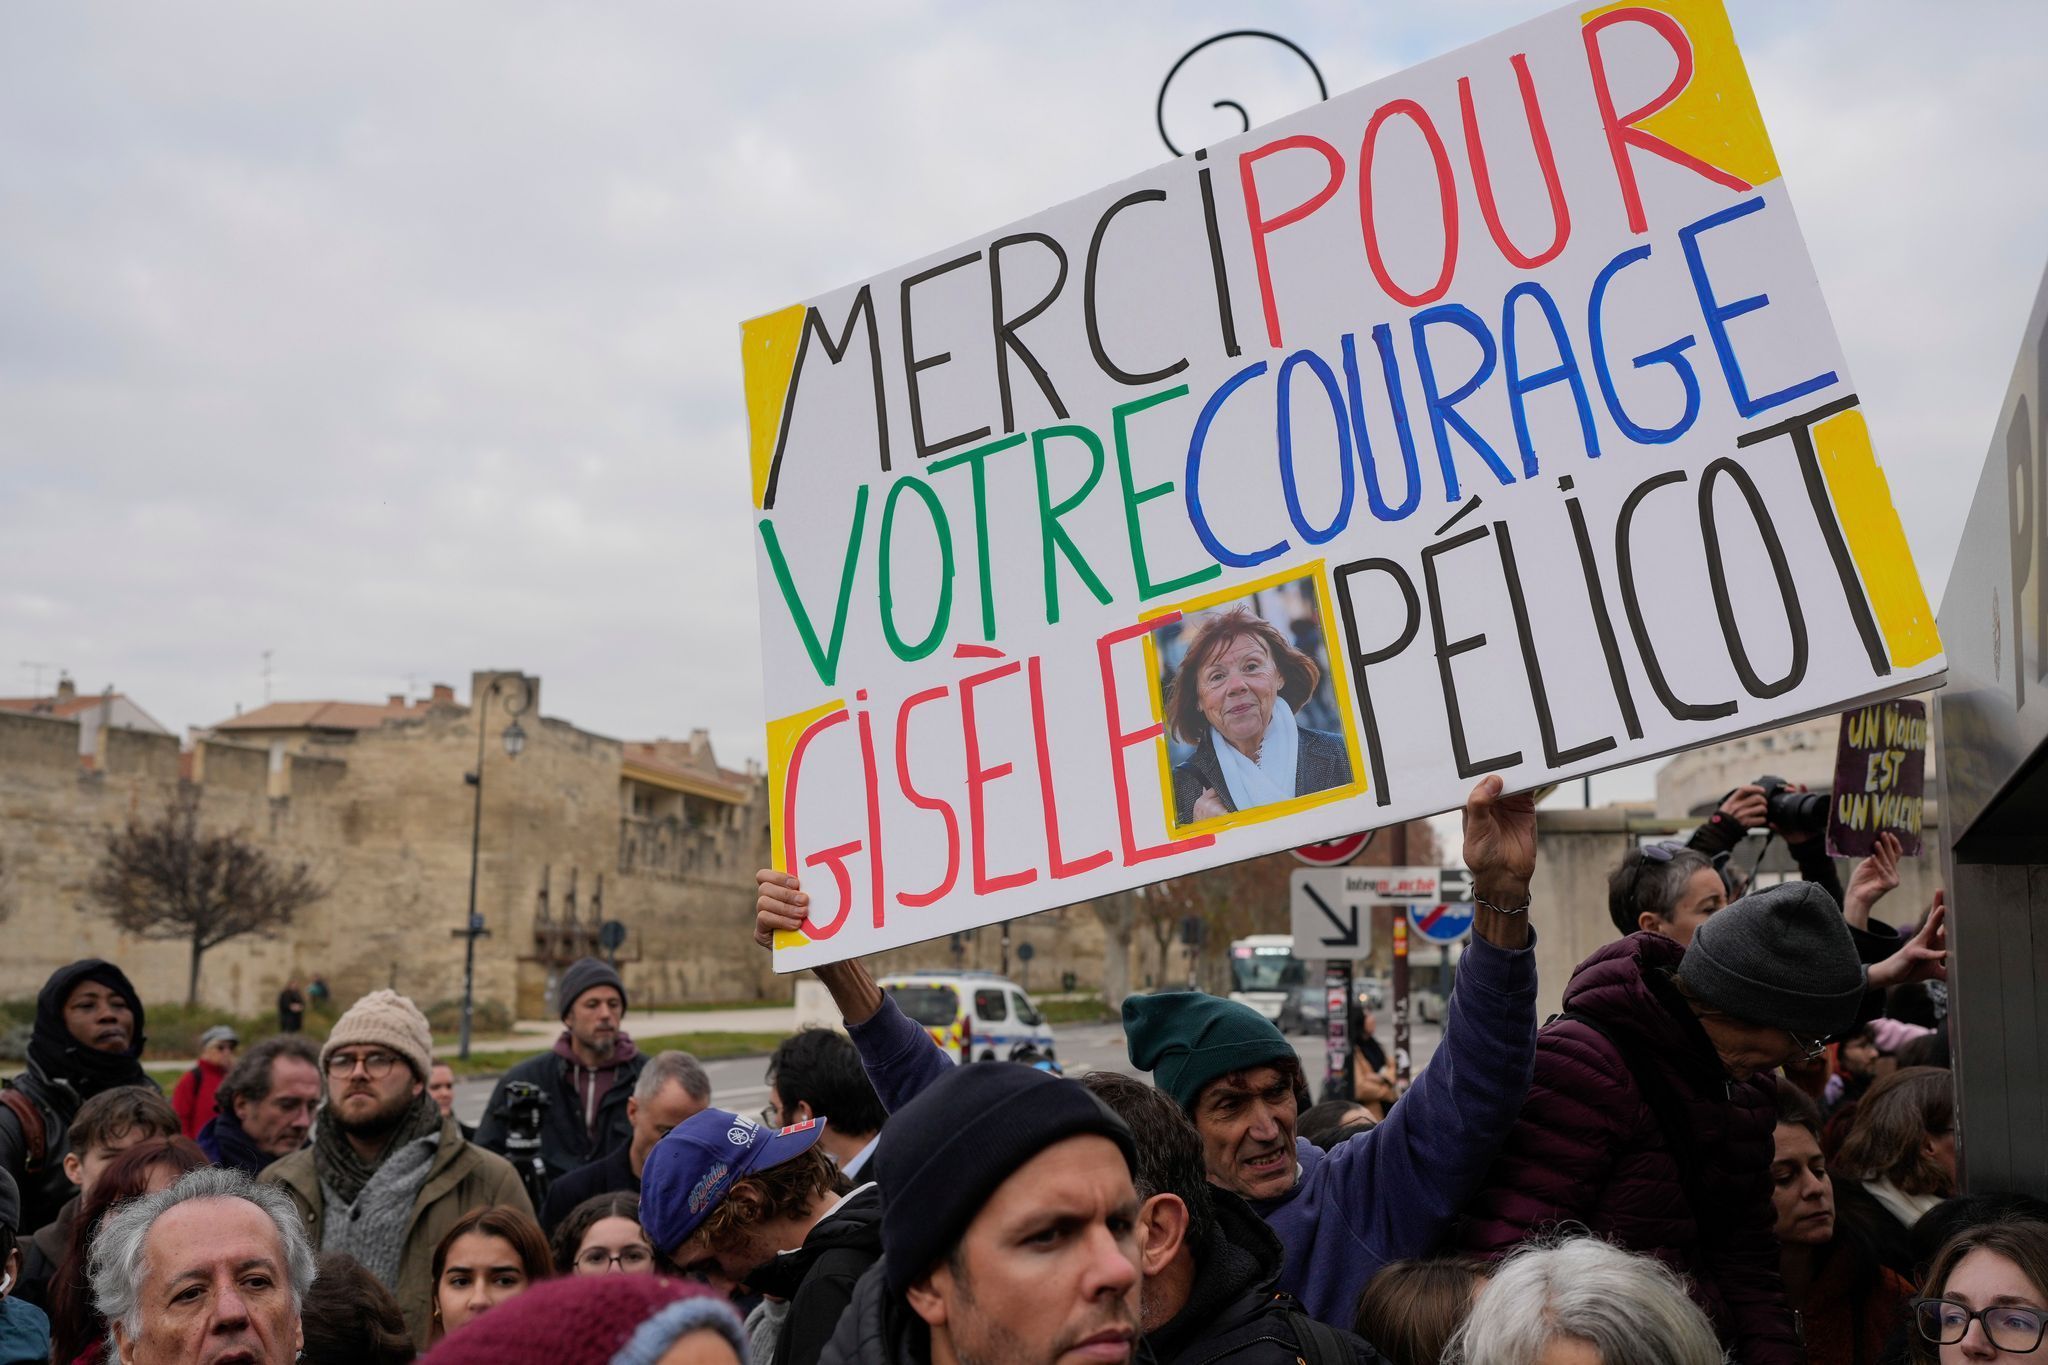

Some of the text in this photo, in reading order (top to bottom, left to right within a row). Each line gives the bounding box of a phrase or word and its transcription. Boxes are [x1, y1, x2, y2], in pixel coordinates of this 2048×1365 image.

[1238, 6, 1755, 349] POUR
[758, 195, 1839, 687] VOTRE COURAGE
[1848, 705, 1881, 750] UN
[1865, 749, 1905, 793] EST
[1838, 793, 1869, 831] UN
